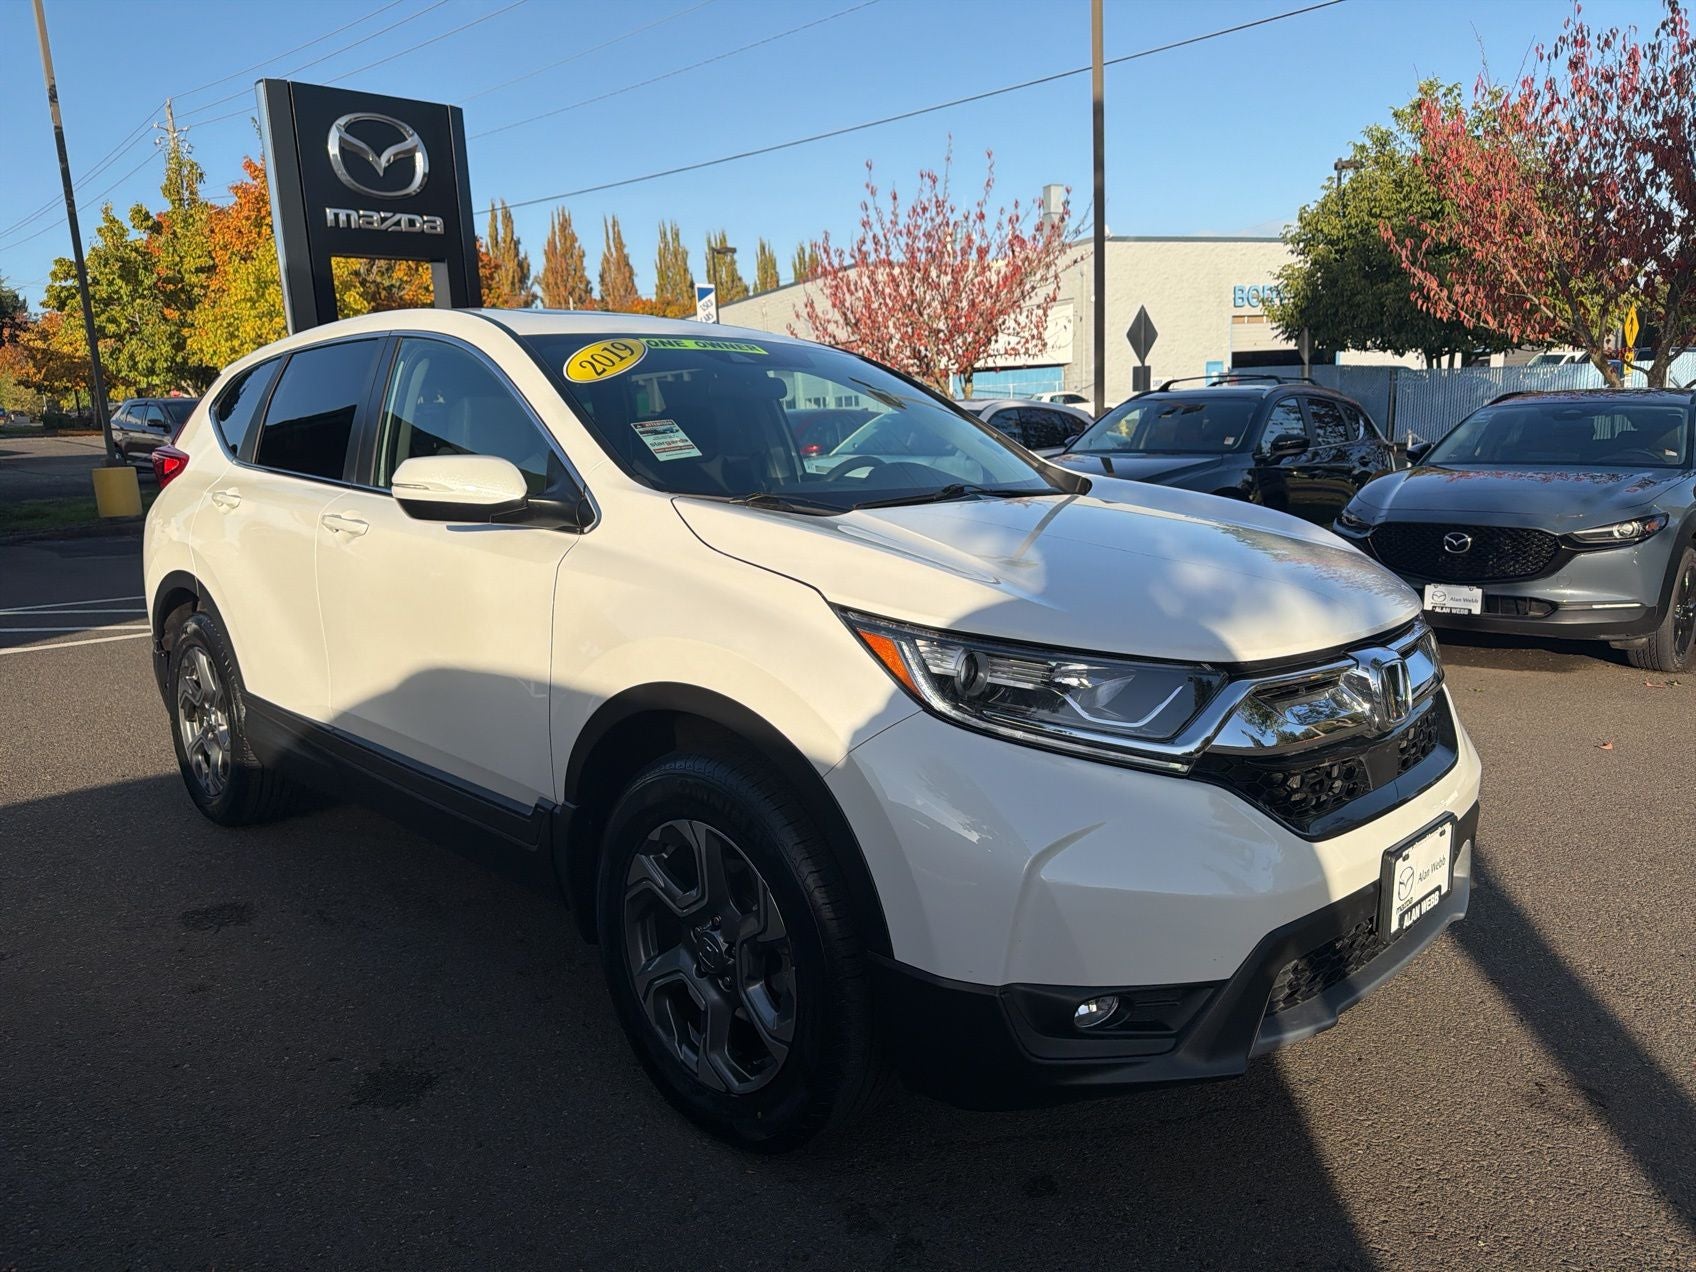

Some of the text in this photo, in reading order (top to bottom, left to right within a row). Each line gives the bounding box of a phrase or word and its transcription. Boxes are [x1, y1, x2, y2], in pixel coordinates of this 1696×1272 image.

[325, 207, 445, 234] mazda
[1233, 284, 1281, 308] BOD
[579, 341, 635, 377] 2019
[645, 339, 764, 353] ONE OWNER
[1418, 855, 1447, 883] Alan Webb
[1403, 890, 1440, 929] ALAN WEBB
